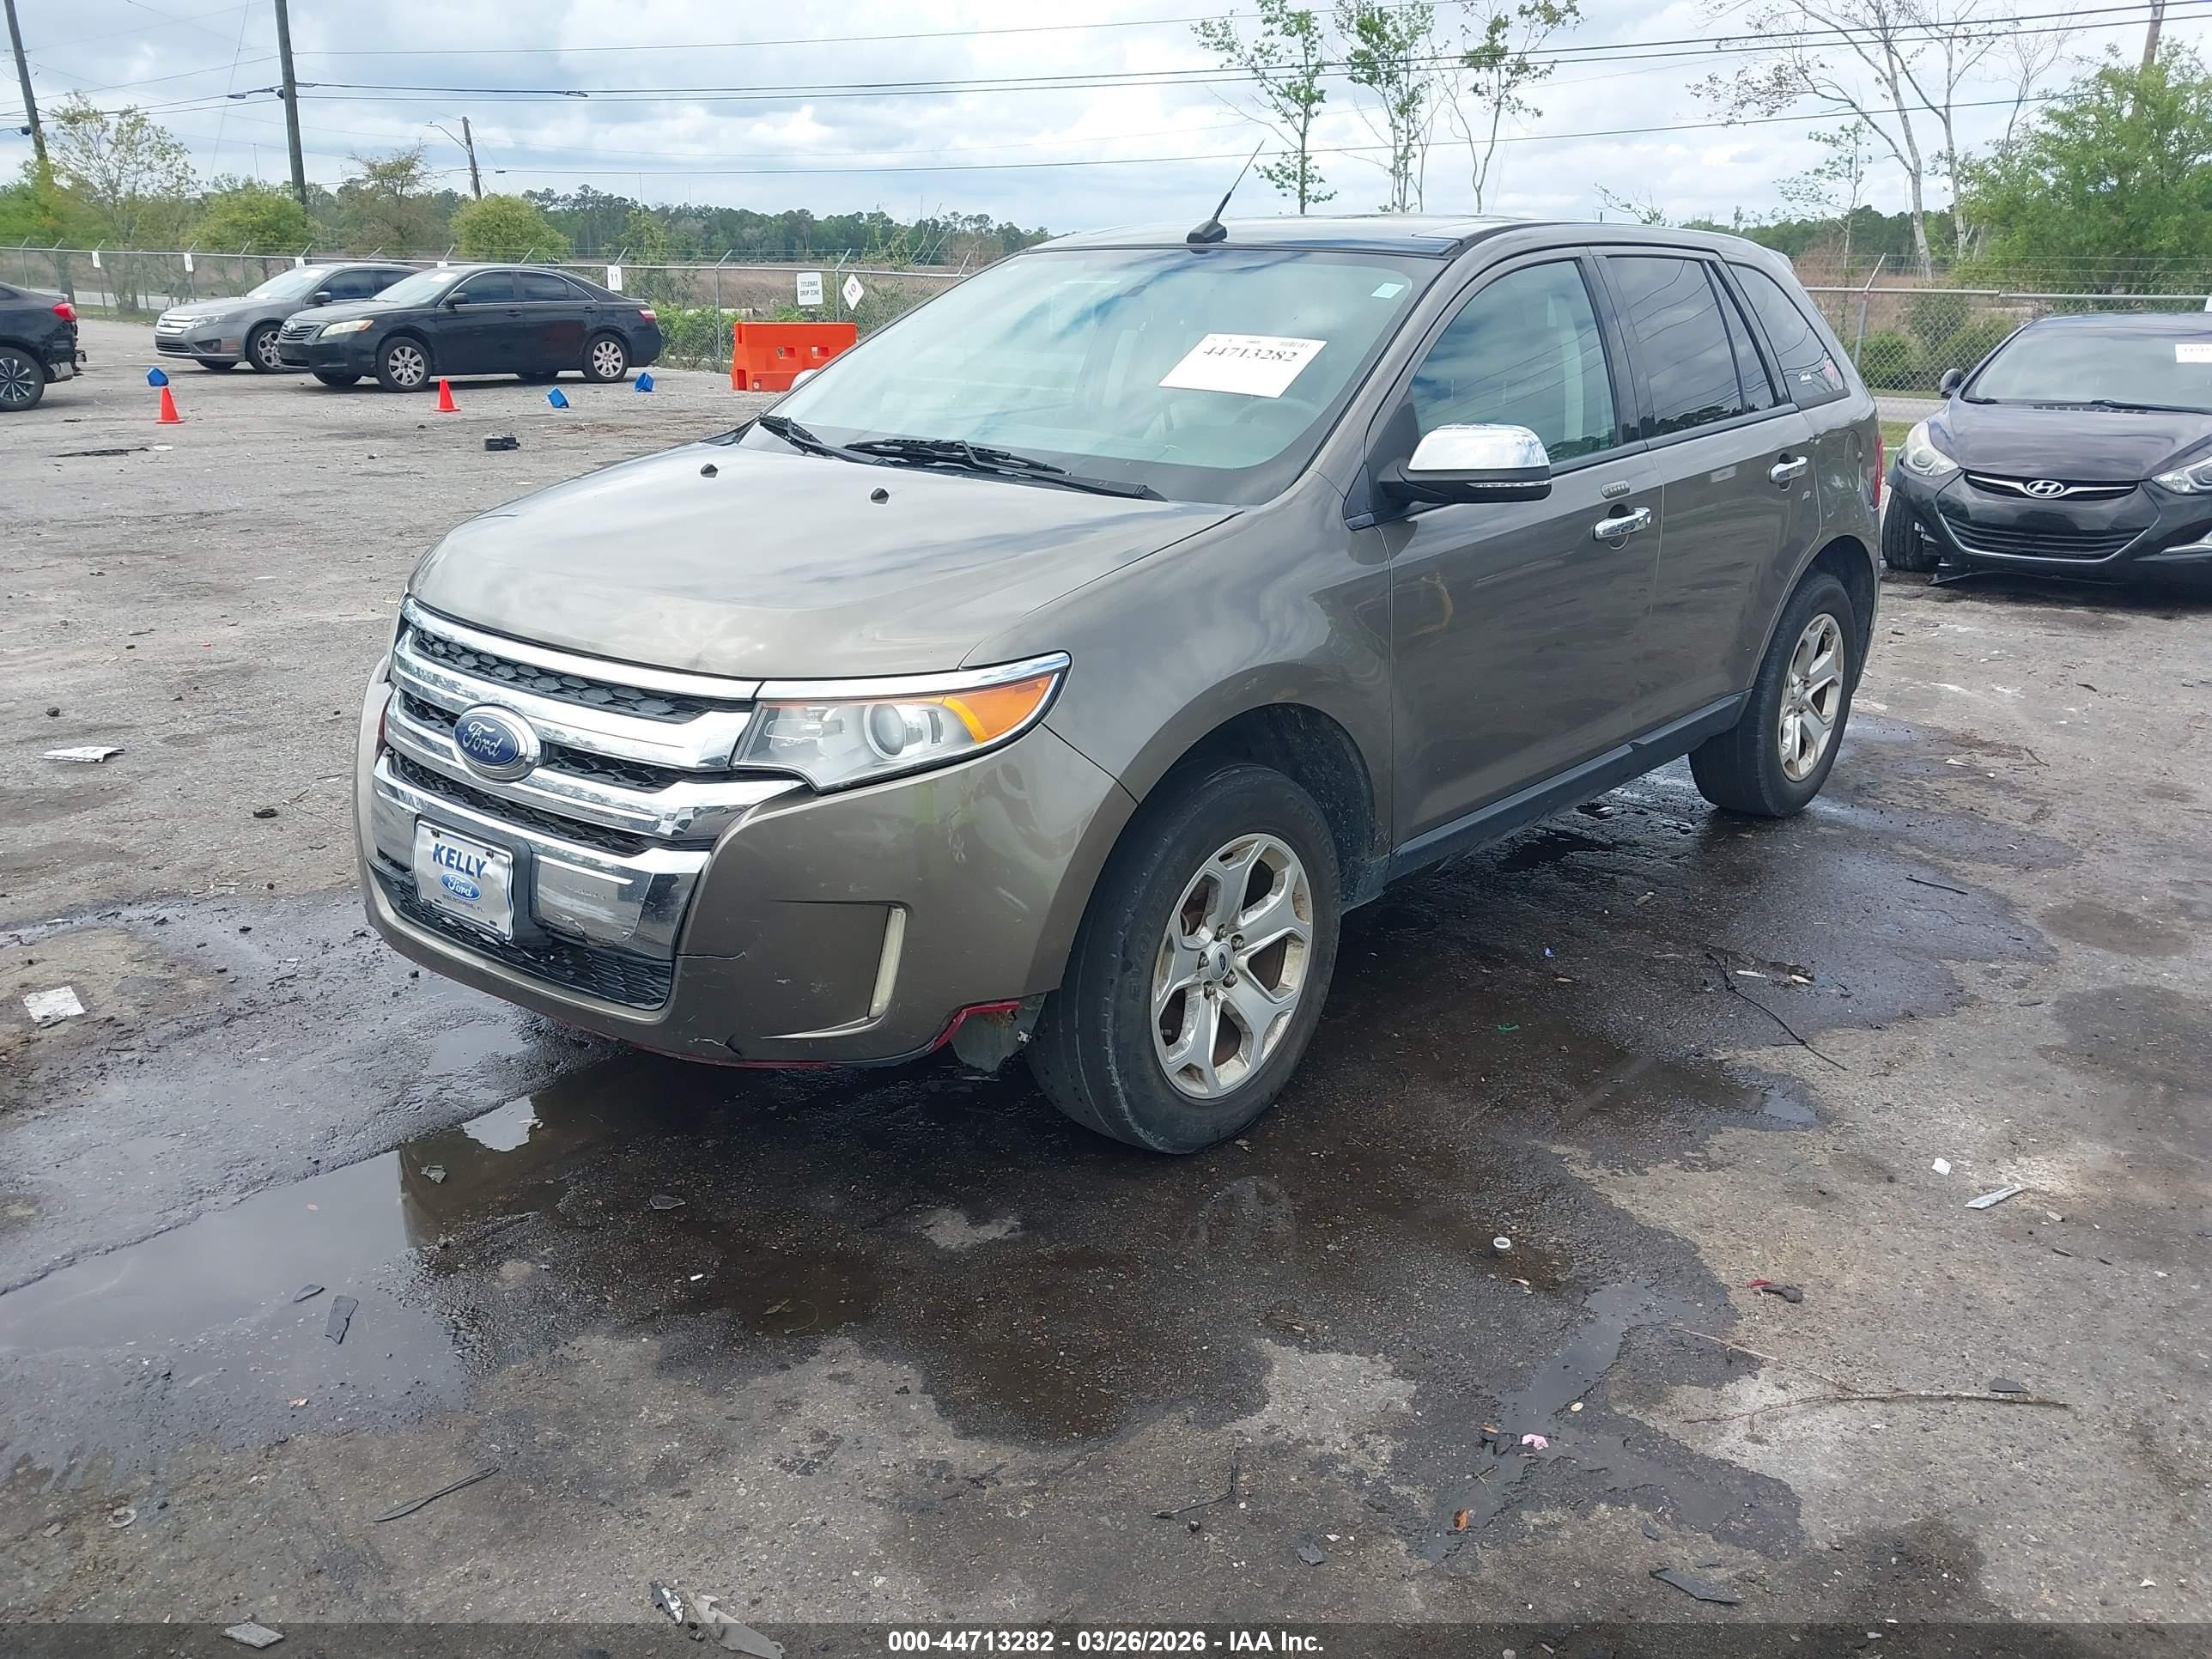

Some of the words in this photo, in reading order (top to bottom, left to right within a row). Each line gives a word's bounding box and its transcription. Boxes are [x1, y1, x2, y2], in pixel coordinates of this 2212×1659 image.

[611, 273, 618, 283] 11
[848, 283, 858, 298] 10
[1202, 345, 1298, 362] 44713282
[462, 720, 504, 758] Ford
[432, 842, 488, 880] KELLY
[447, 876, 474, 898] Ford
